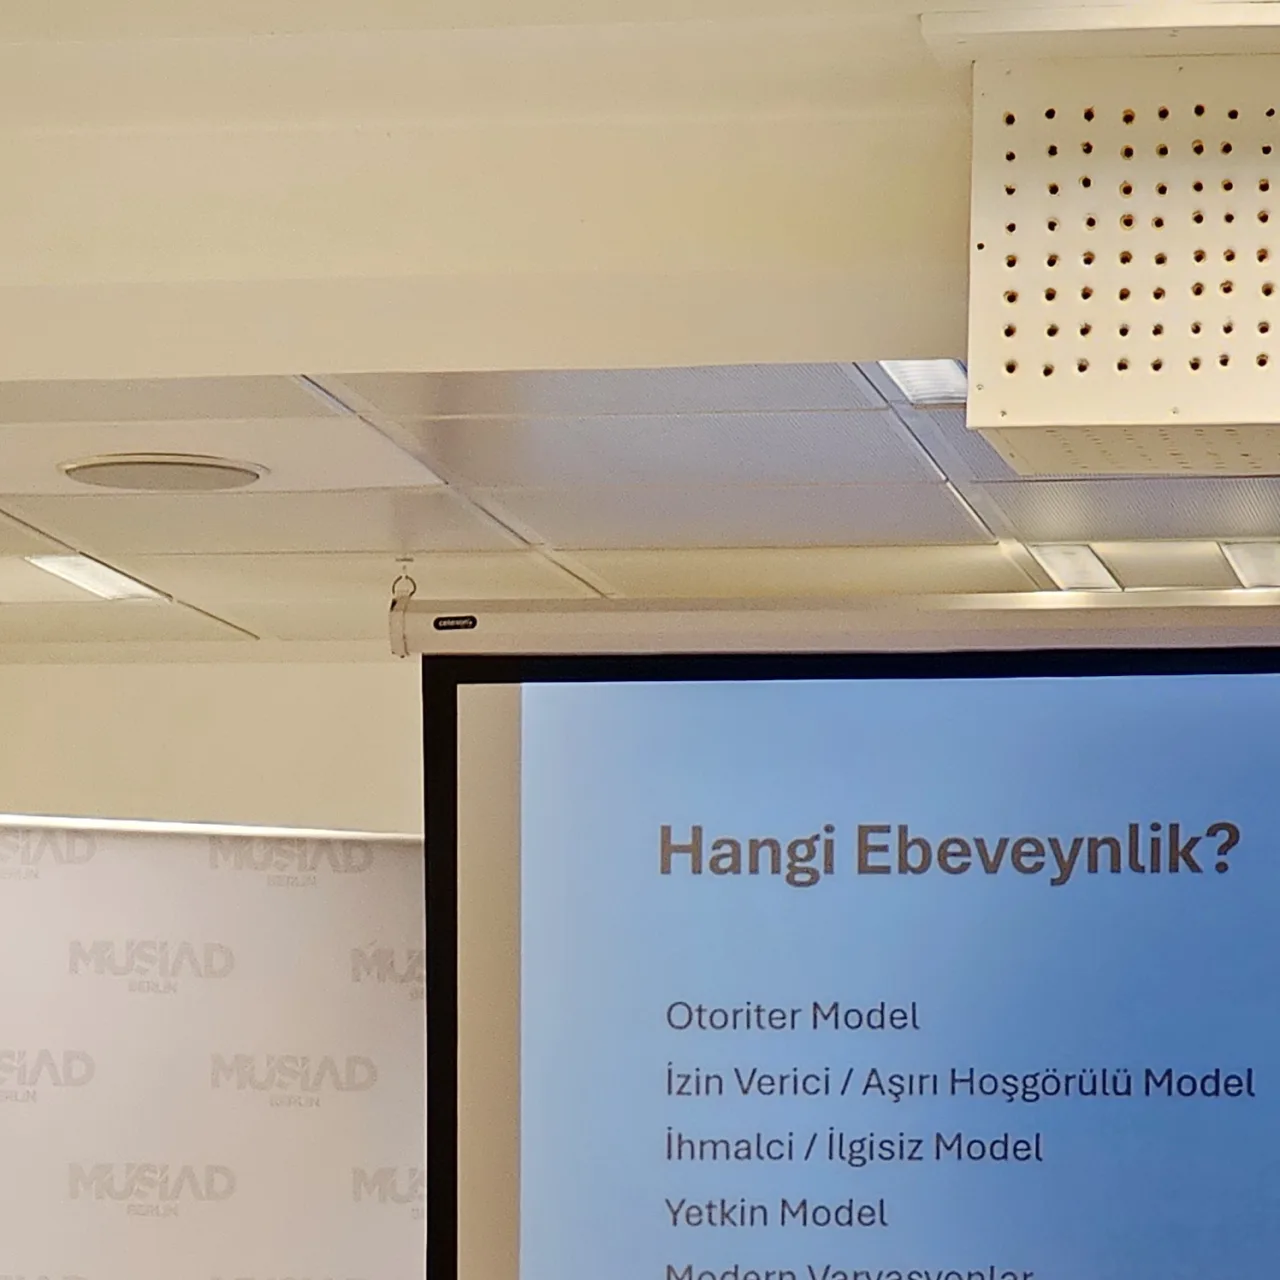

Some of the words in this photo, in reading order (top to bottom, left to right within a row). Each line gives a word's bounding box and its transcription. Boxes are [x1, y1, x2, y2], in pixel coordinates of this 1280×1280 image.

[659, 823, 836, 888] Hangi
[857, 821, 1241, 887] Ebeveynlik?
[666, 1000, 803, 1031] Otoriter
[812, 1000, 920, 1031] Model
[666, 1060, 724, 1097] İzin
[733, 1061, 830, 1097] Verici
[862, 1067, 938, 1104] Aşırı
[950, 1066, 1132, 1104] Hoşgörülü
[1144, 1067, 1256, 1098] Model
[666, 1125, 794, 1161] İhmalci
[827, 1126, 924, 1168] İlgisiz
[935, 1131, 1043, 1163] Model
[664, 1197, 768, 1228] Yetkin
[780, 1197, 889, 1228] Model
